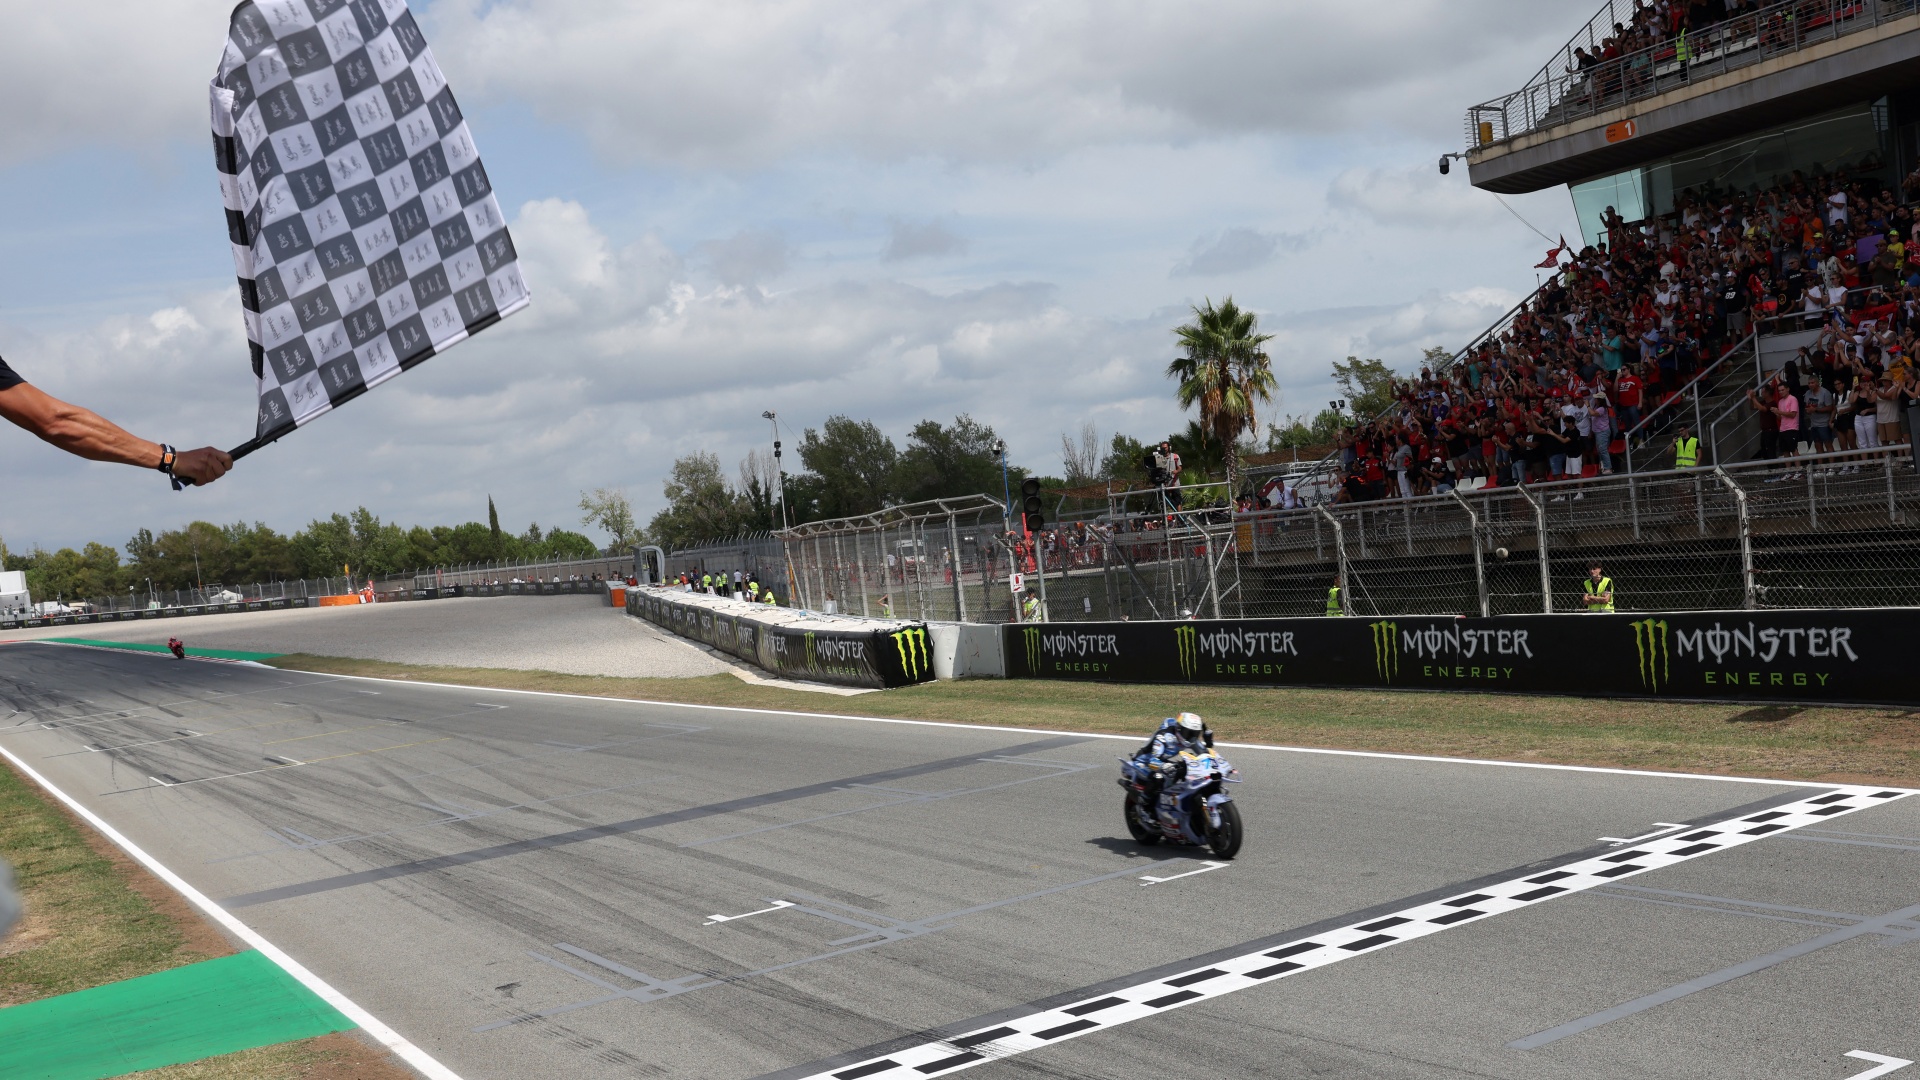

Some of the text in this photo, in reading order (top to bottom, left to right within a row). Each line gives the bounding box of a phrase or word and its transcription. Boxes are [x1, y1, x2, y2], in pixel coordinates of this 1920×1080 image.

[1624, 121, 1632, 136] 1
[816, 636, 867, 661] MONSTER
[1042, 630, 1119, 657] MONSTER
[1200, 627, 1298, 658] MONSTER
[1403, 623, 1534, 660] MONSTER
[1676, 621, 1858, 664] MONSTER
[827, 665, 862, 676] ENERGY
[1055, 662, 1109, 672] ENERGY
[1216, 664, 1284, 674] ENERGY
[1424, 665, 1514, 679] ENERGY
[1705, 671, 1830, 686] ENERGY
